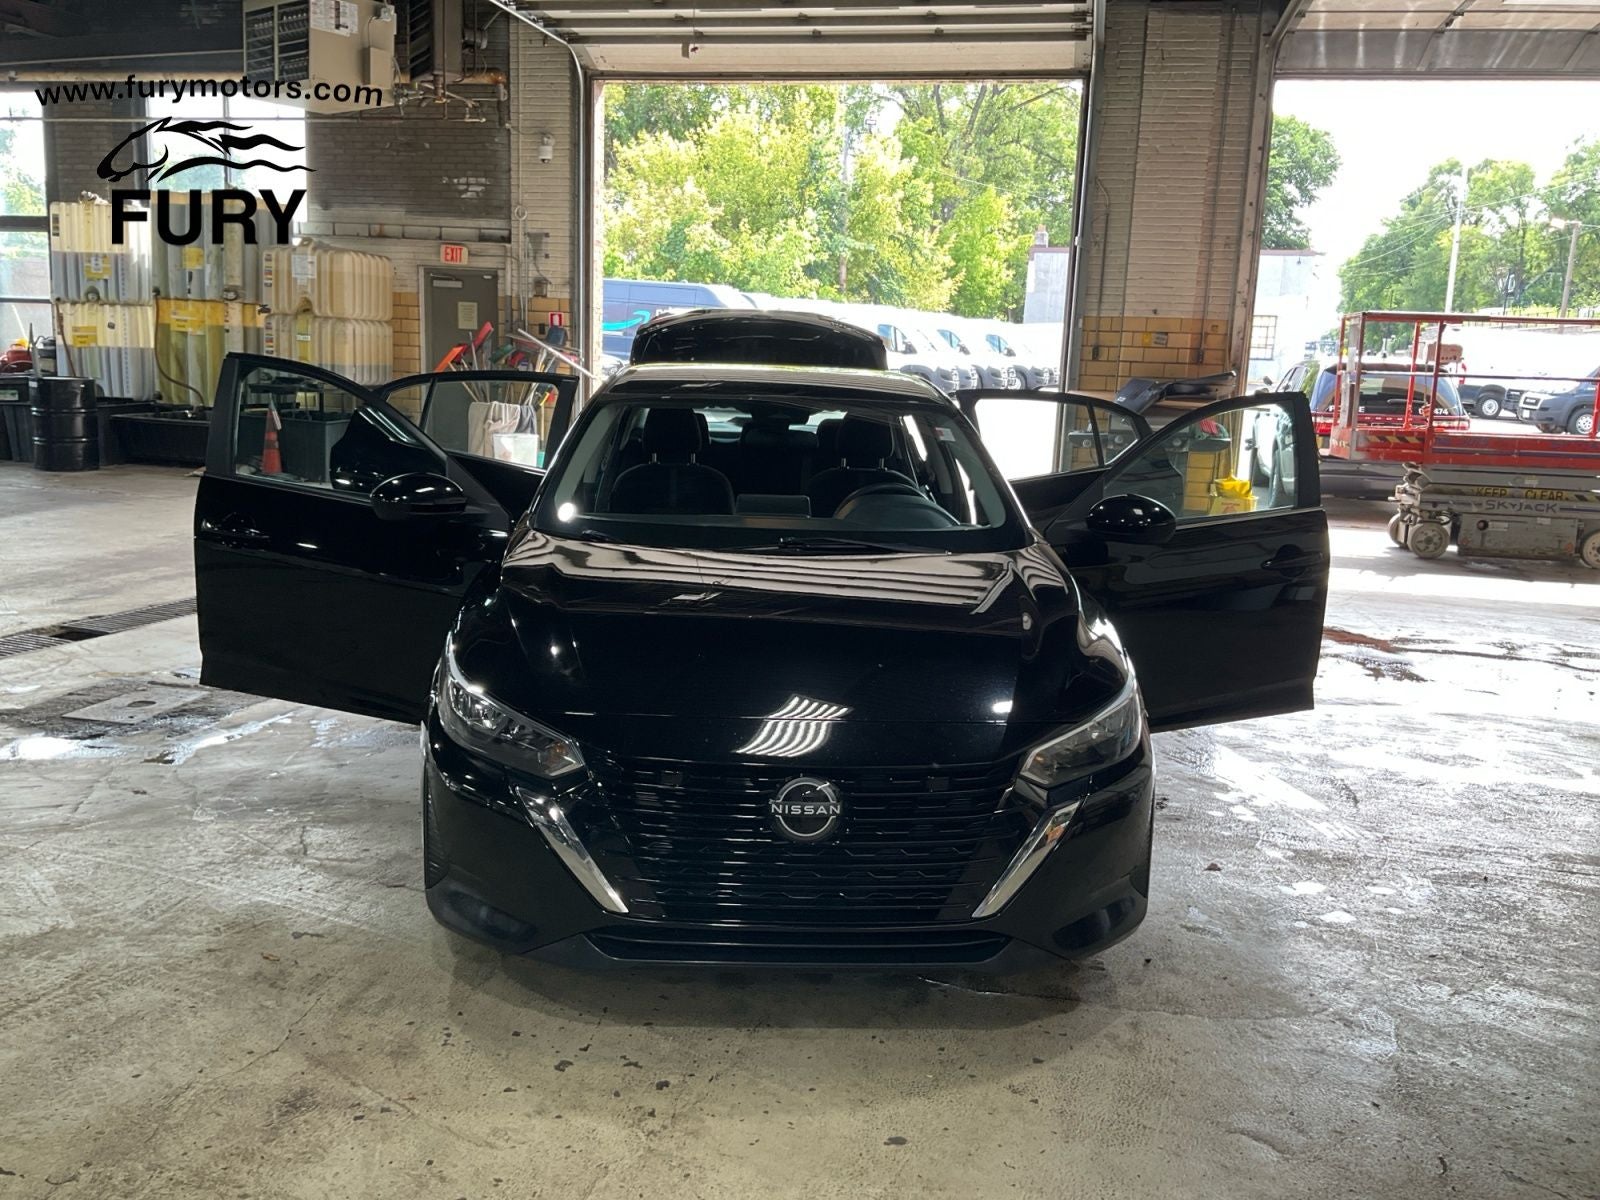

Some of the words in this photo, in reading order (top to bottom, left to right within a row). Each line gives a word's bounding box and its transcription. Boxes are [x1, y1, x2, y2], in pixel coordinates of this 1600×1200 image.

[444, 246, 463, 262] EXIT
[1476, 487, 1508, 498] KEEP
[1524, 489, 1564, 500] CLEAR
[1485, 500, 1558, 513] SKYJACK
[771, 804, 840, 815] NISSAN
